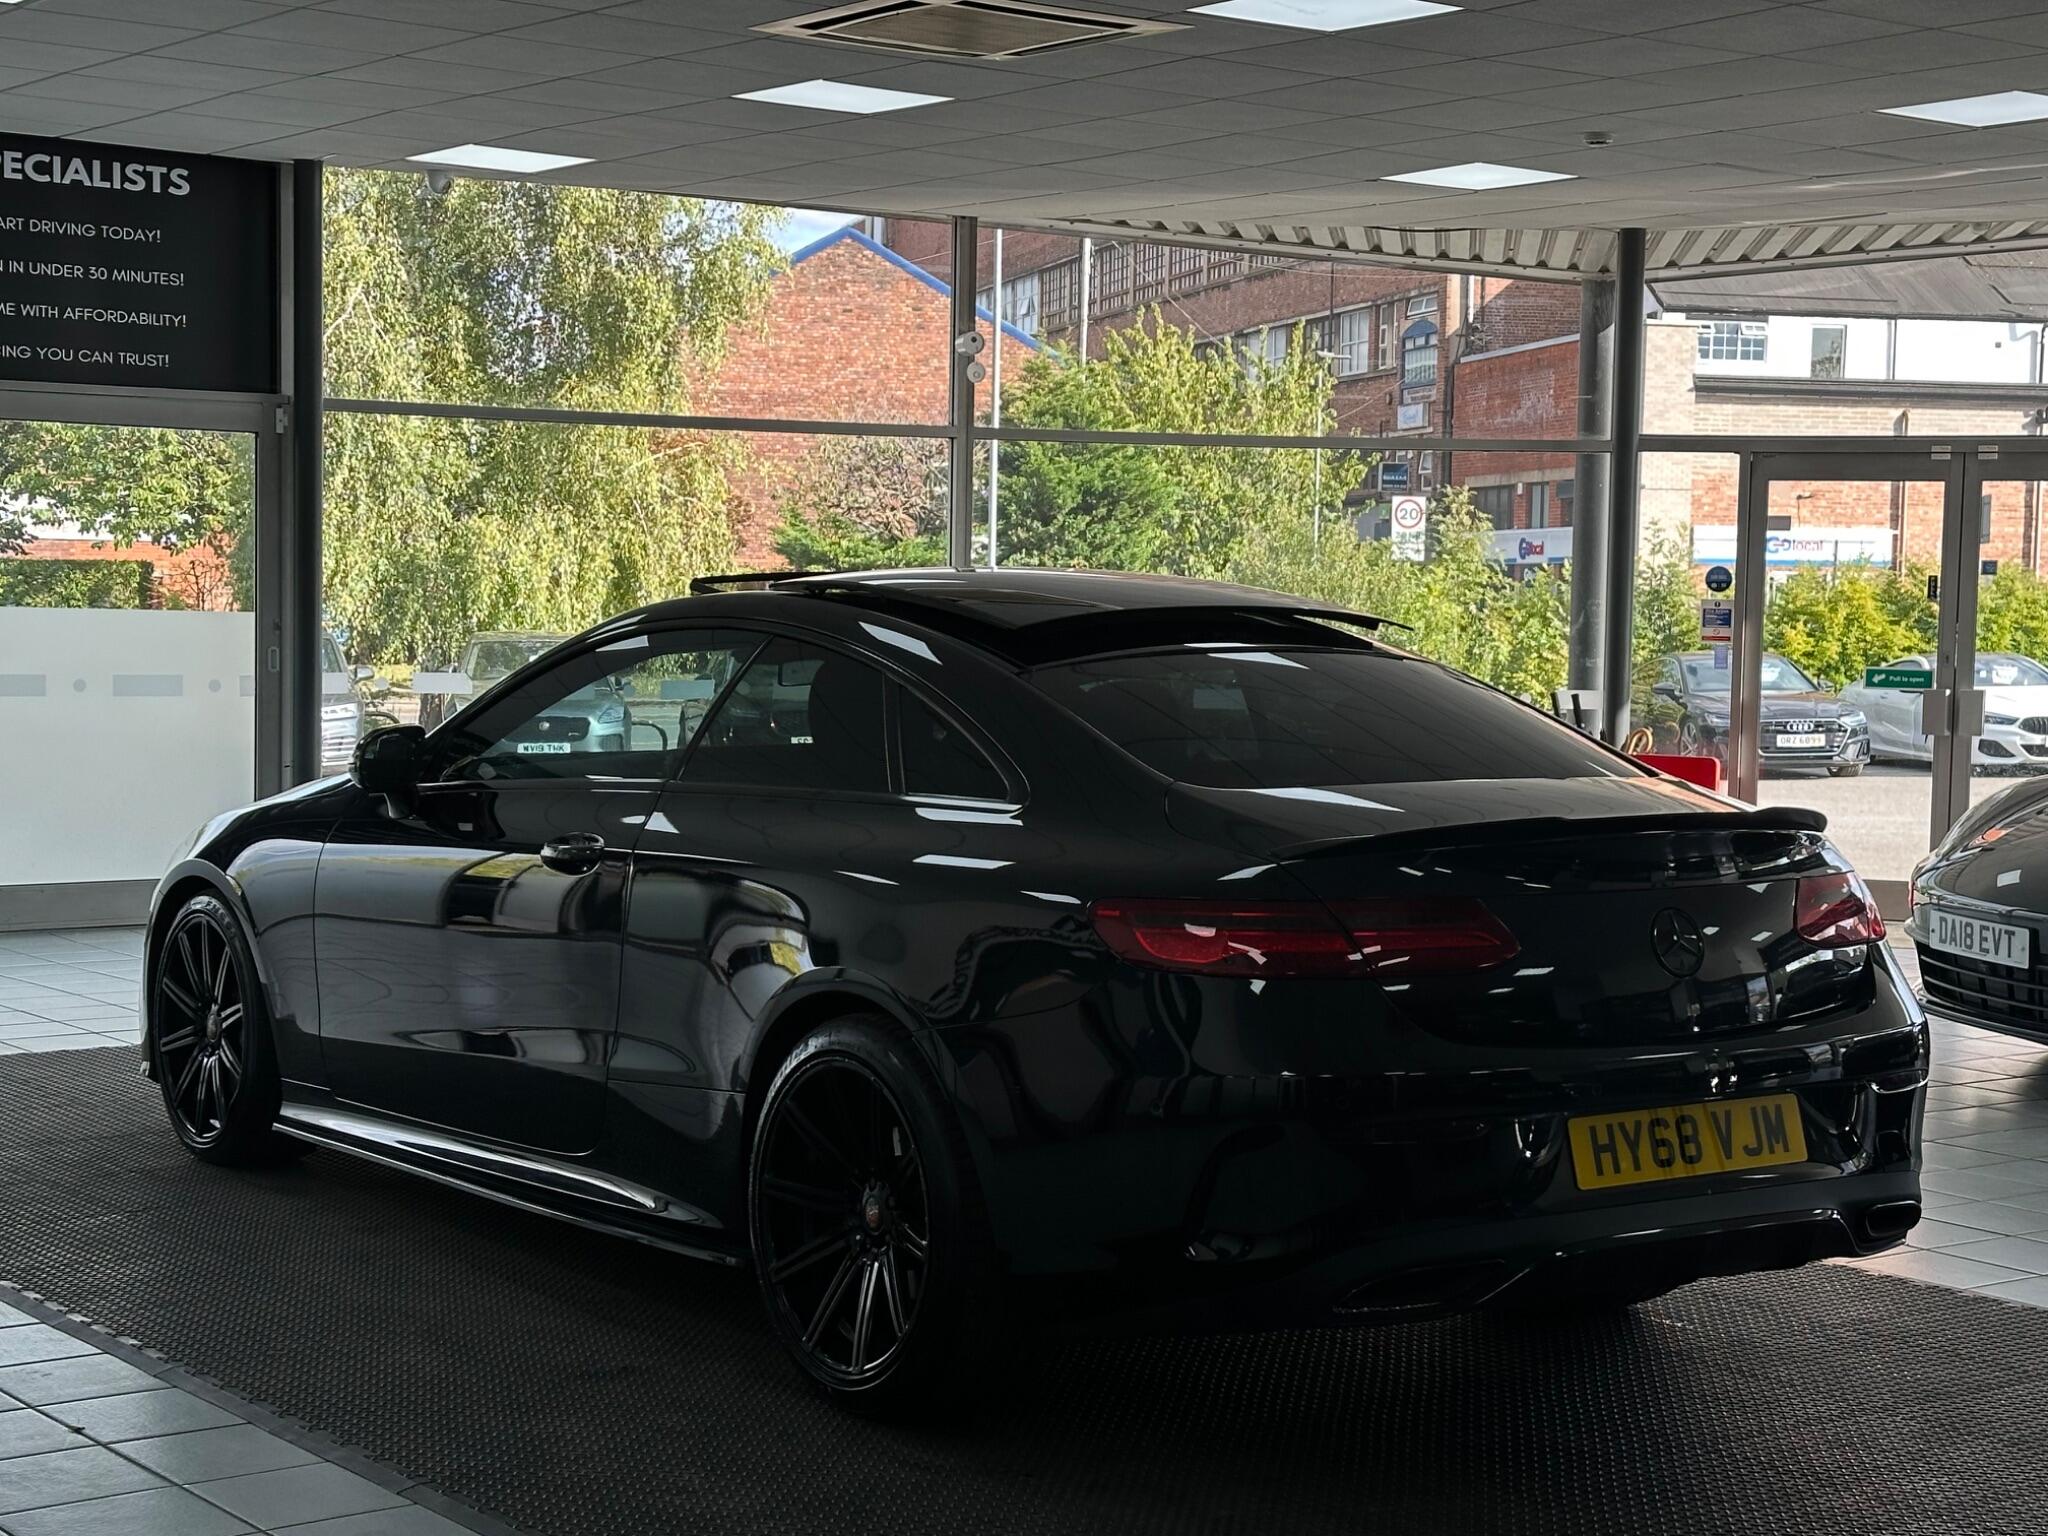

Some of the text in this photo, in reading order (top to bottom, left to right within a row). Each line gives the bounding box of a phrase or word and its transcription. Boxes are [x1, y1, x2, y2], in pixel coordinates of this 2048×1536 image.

[0, 150, 191, 196] ECIALISTS
[29, 218, 96, 237] DRIVING
[101, 225, 161, 243] TODAY!
[9, 260, 24, 273] IN
[29, 262, 84, 279] UNDER
[88, 266, 108, 280] 30
[112, 269, 184, 286] MINUTES!
[21, 303, 58, 319] WITH
[63, 307, 187, 328] AFFORDABILITY!
[0, 344, 169, 367] ING YOU CAN TRUST!
[1399, 507, 1419, 521] 20
[1938, 916, 2016, 958] DA18 EVT
[1588, 1103, 1790, 1177] HY68 VJM
